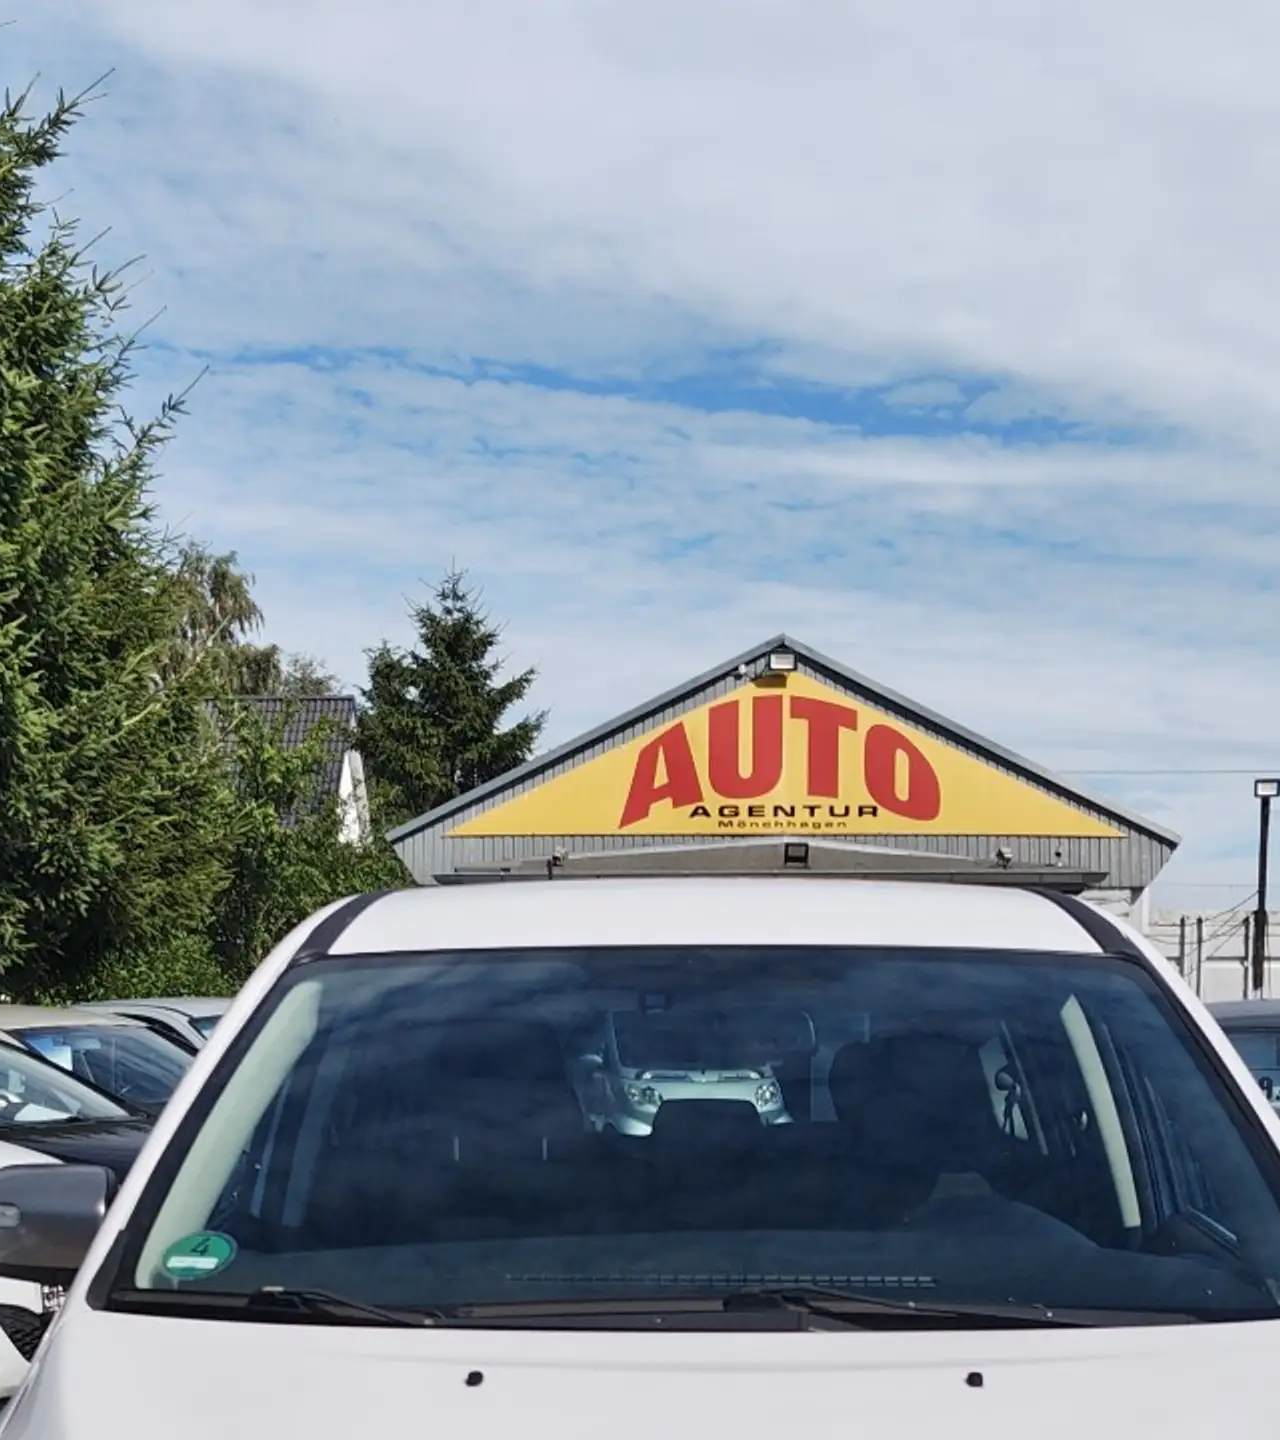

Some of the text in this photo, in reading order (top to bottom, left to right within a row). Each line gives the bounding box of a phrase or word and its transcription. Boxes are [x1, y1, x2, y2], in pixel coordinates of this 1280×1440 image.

[618, 694, 941, 830] AUTO
[689, 805, 878, 818] AGENTUR
[718, 819, 847, 829] Mönchhagen
[190, 1237, 210, 1256] 4
